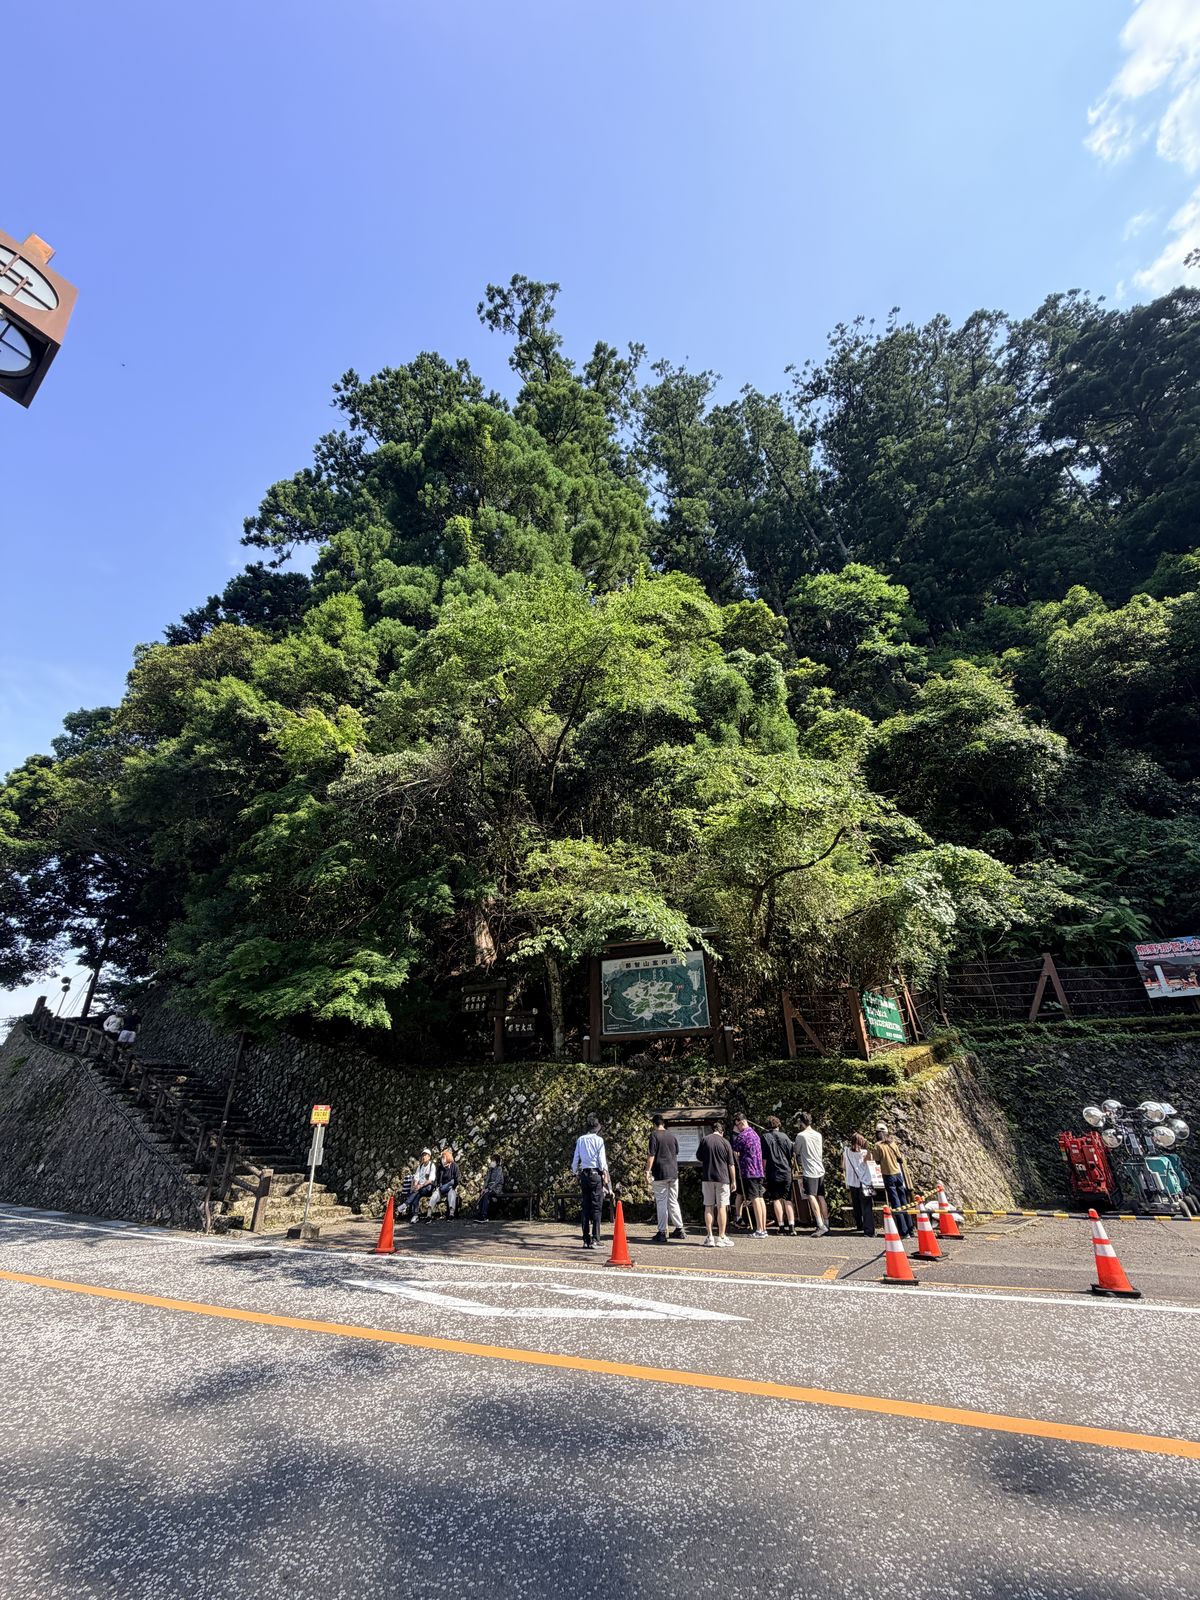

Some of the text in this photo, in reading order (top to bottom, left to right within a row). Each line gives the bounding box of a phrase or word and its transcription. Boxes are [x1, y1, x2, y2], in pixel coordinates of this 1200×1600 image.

[625, 958, 677, 968] 那智山案内図
